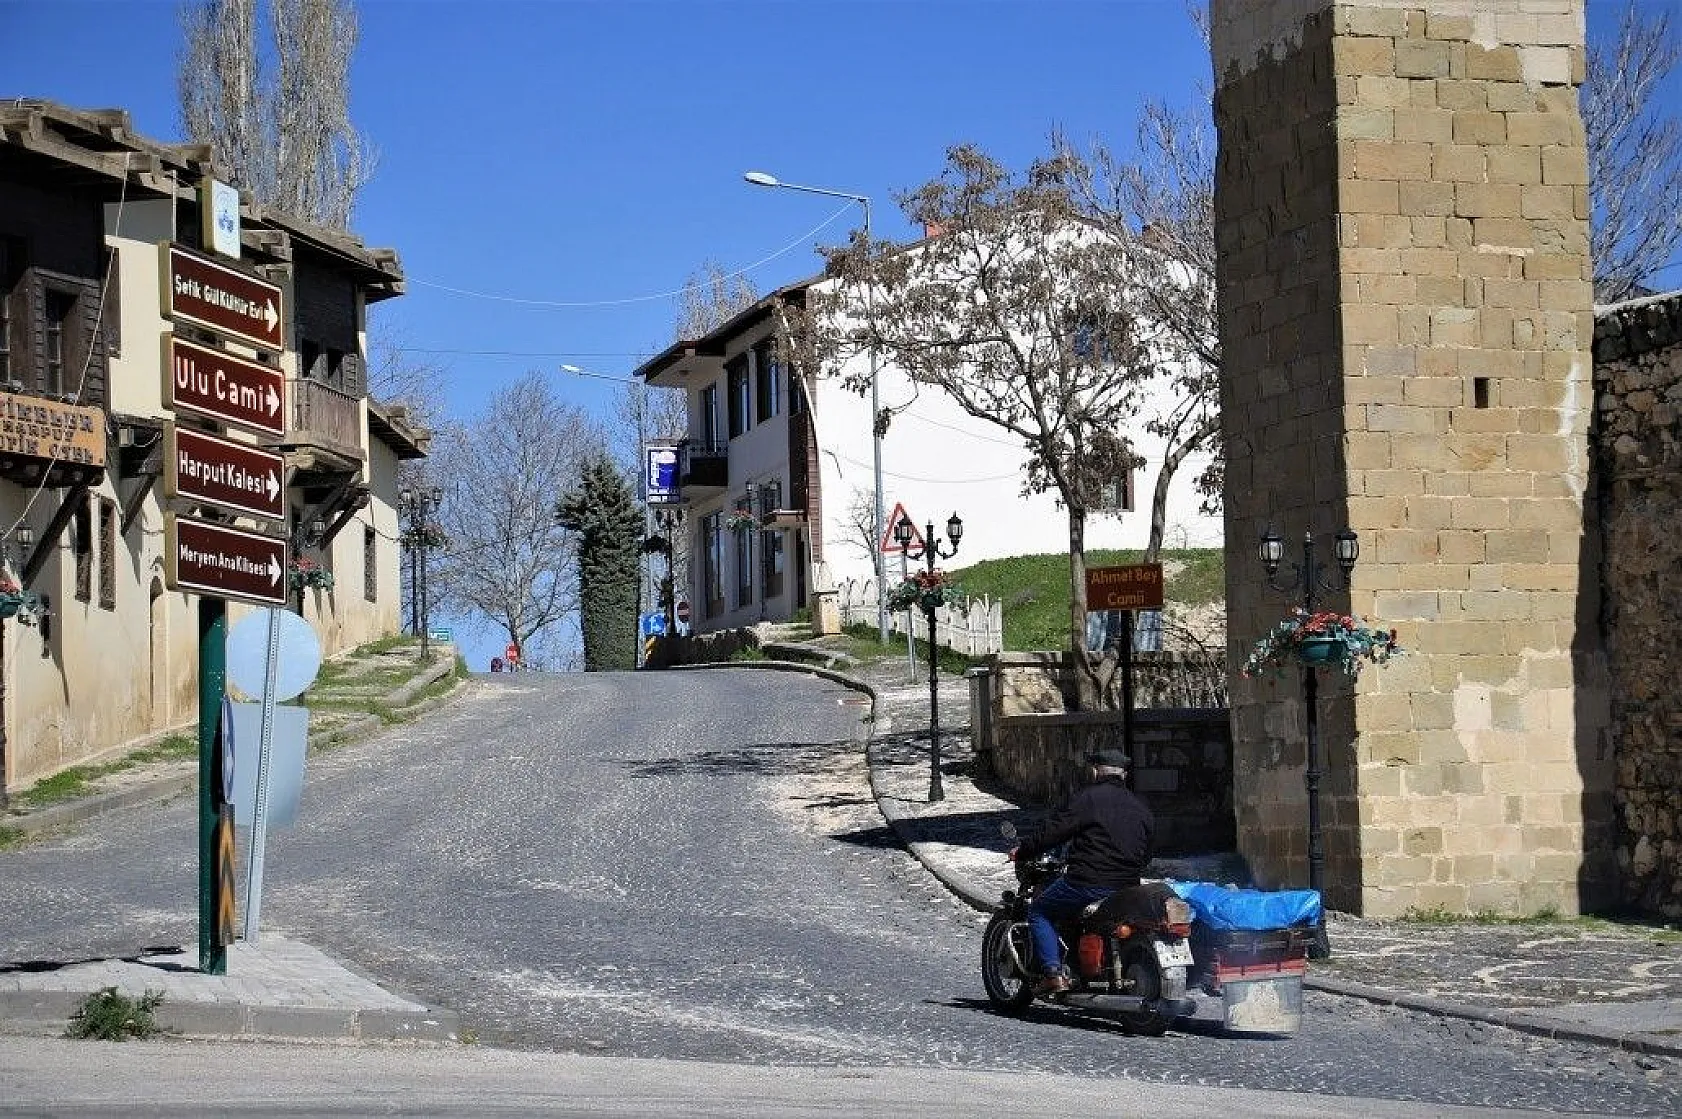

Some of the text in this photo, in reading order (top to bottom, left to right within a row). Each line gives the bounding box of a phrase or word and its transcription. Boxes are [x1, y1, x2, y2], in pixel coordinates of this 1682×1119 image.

[176, 356, 264, 412] Ulu Cami
[179, 449, 265, 495] Harput Kalesi
[180, 544, 267, 577] Meryem Ana Kilisesi
[1091, 568, 1158, 585] Ahmet Bey
